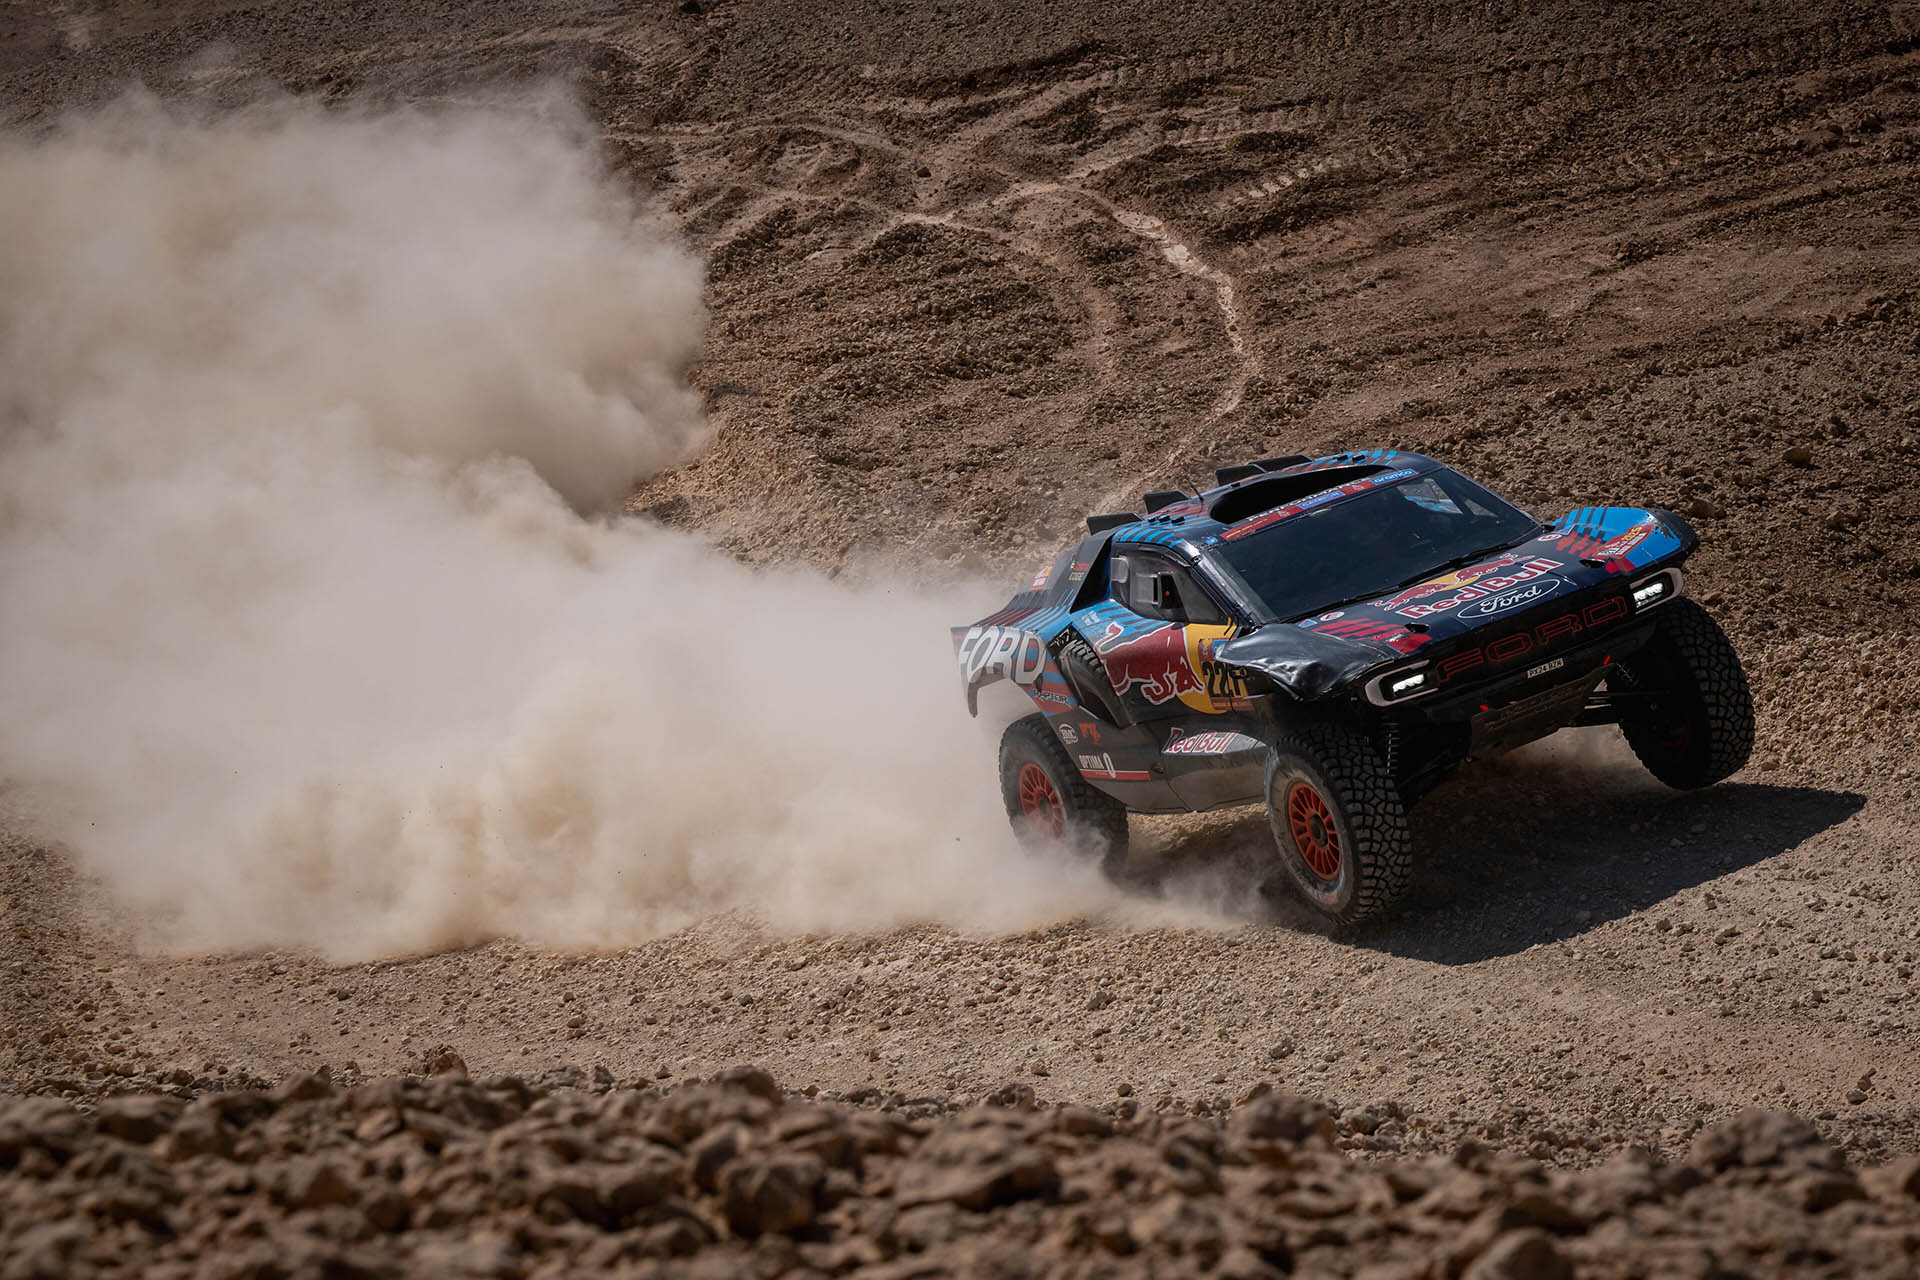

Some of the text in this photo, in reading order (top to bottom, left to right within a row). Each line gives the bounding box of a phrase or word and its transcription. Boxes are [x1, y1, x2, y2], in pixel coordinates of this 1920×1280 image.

[1374, 470, 1412, 483] aramco
[1395, 558, 1565, 619] Red Bull
[1480, 585, 1542, 613] Ford
[1435, 595, 1629, 683] FORD
[958, 625, 1047, 685] FORD
[1161, 727, 1239, 754] Red Bull
[1078, 754, 1105, 769] OPTIMA
